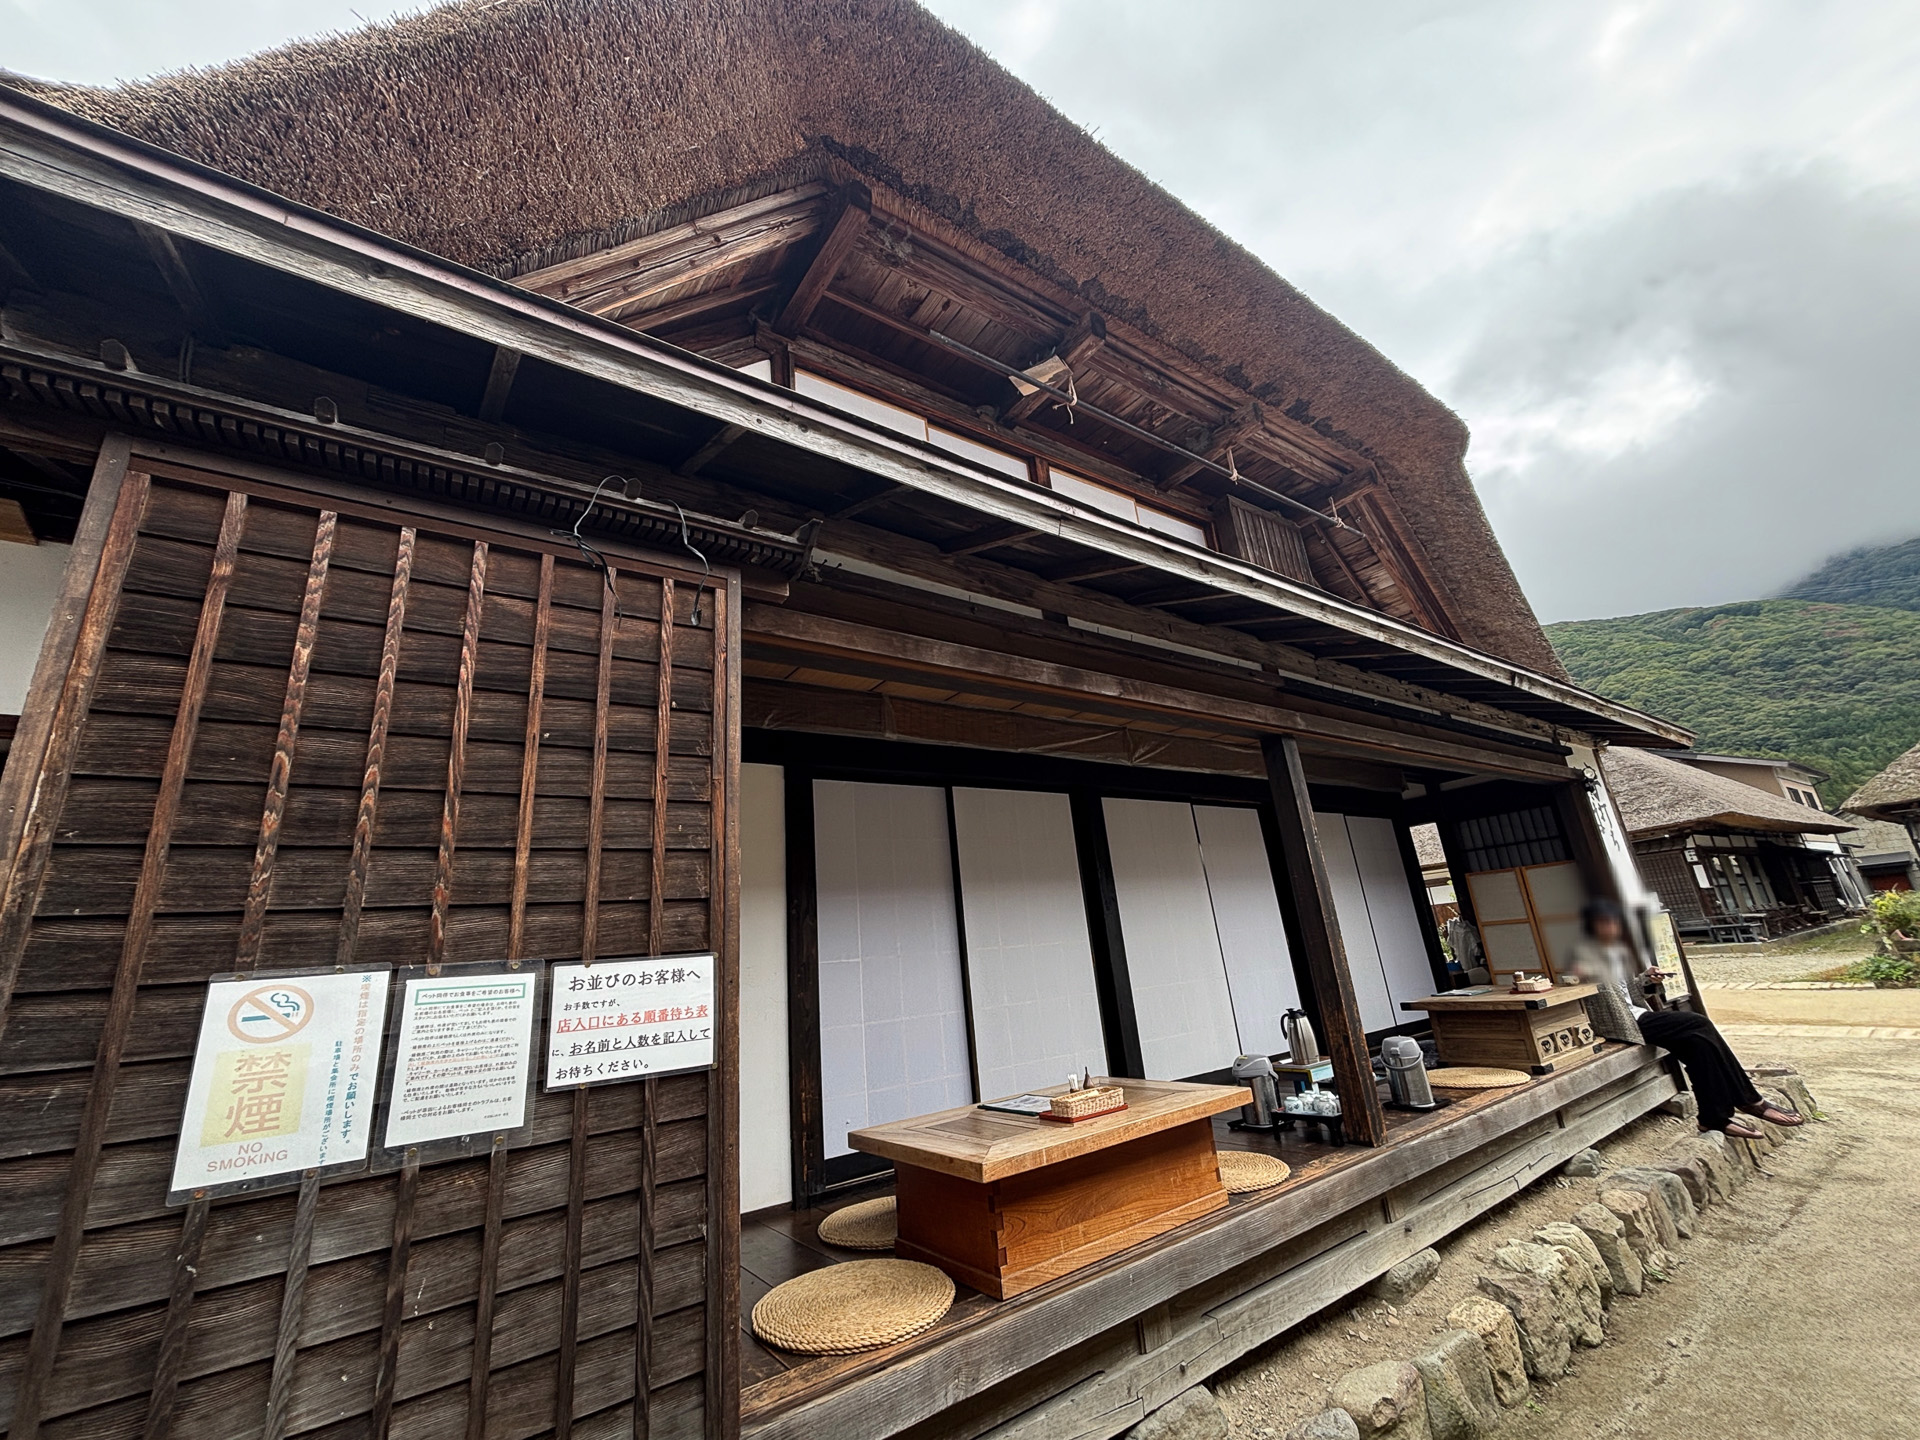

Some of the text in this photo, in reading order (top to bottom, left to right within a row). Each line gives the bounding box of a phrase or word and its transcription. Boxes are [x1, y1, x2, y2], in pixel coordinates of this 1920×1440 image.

[569, 968, 700, 992] お並びのお客様へ
[564, 999, 621, 1011] お手数ですが、
[556, 1005, 708, 1033] 店入口にある順番待ち表
[556, 1059, 650, 1080] お待ちください。
[224, 1051, 292, 1138] 禁煙
[238, 1142, 263, 1155] NO
[207, 1150, 288, 1172] SMOKING
